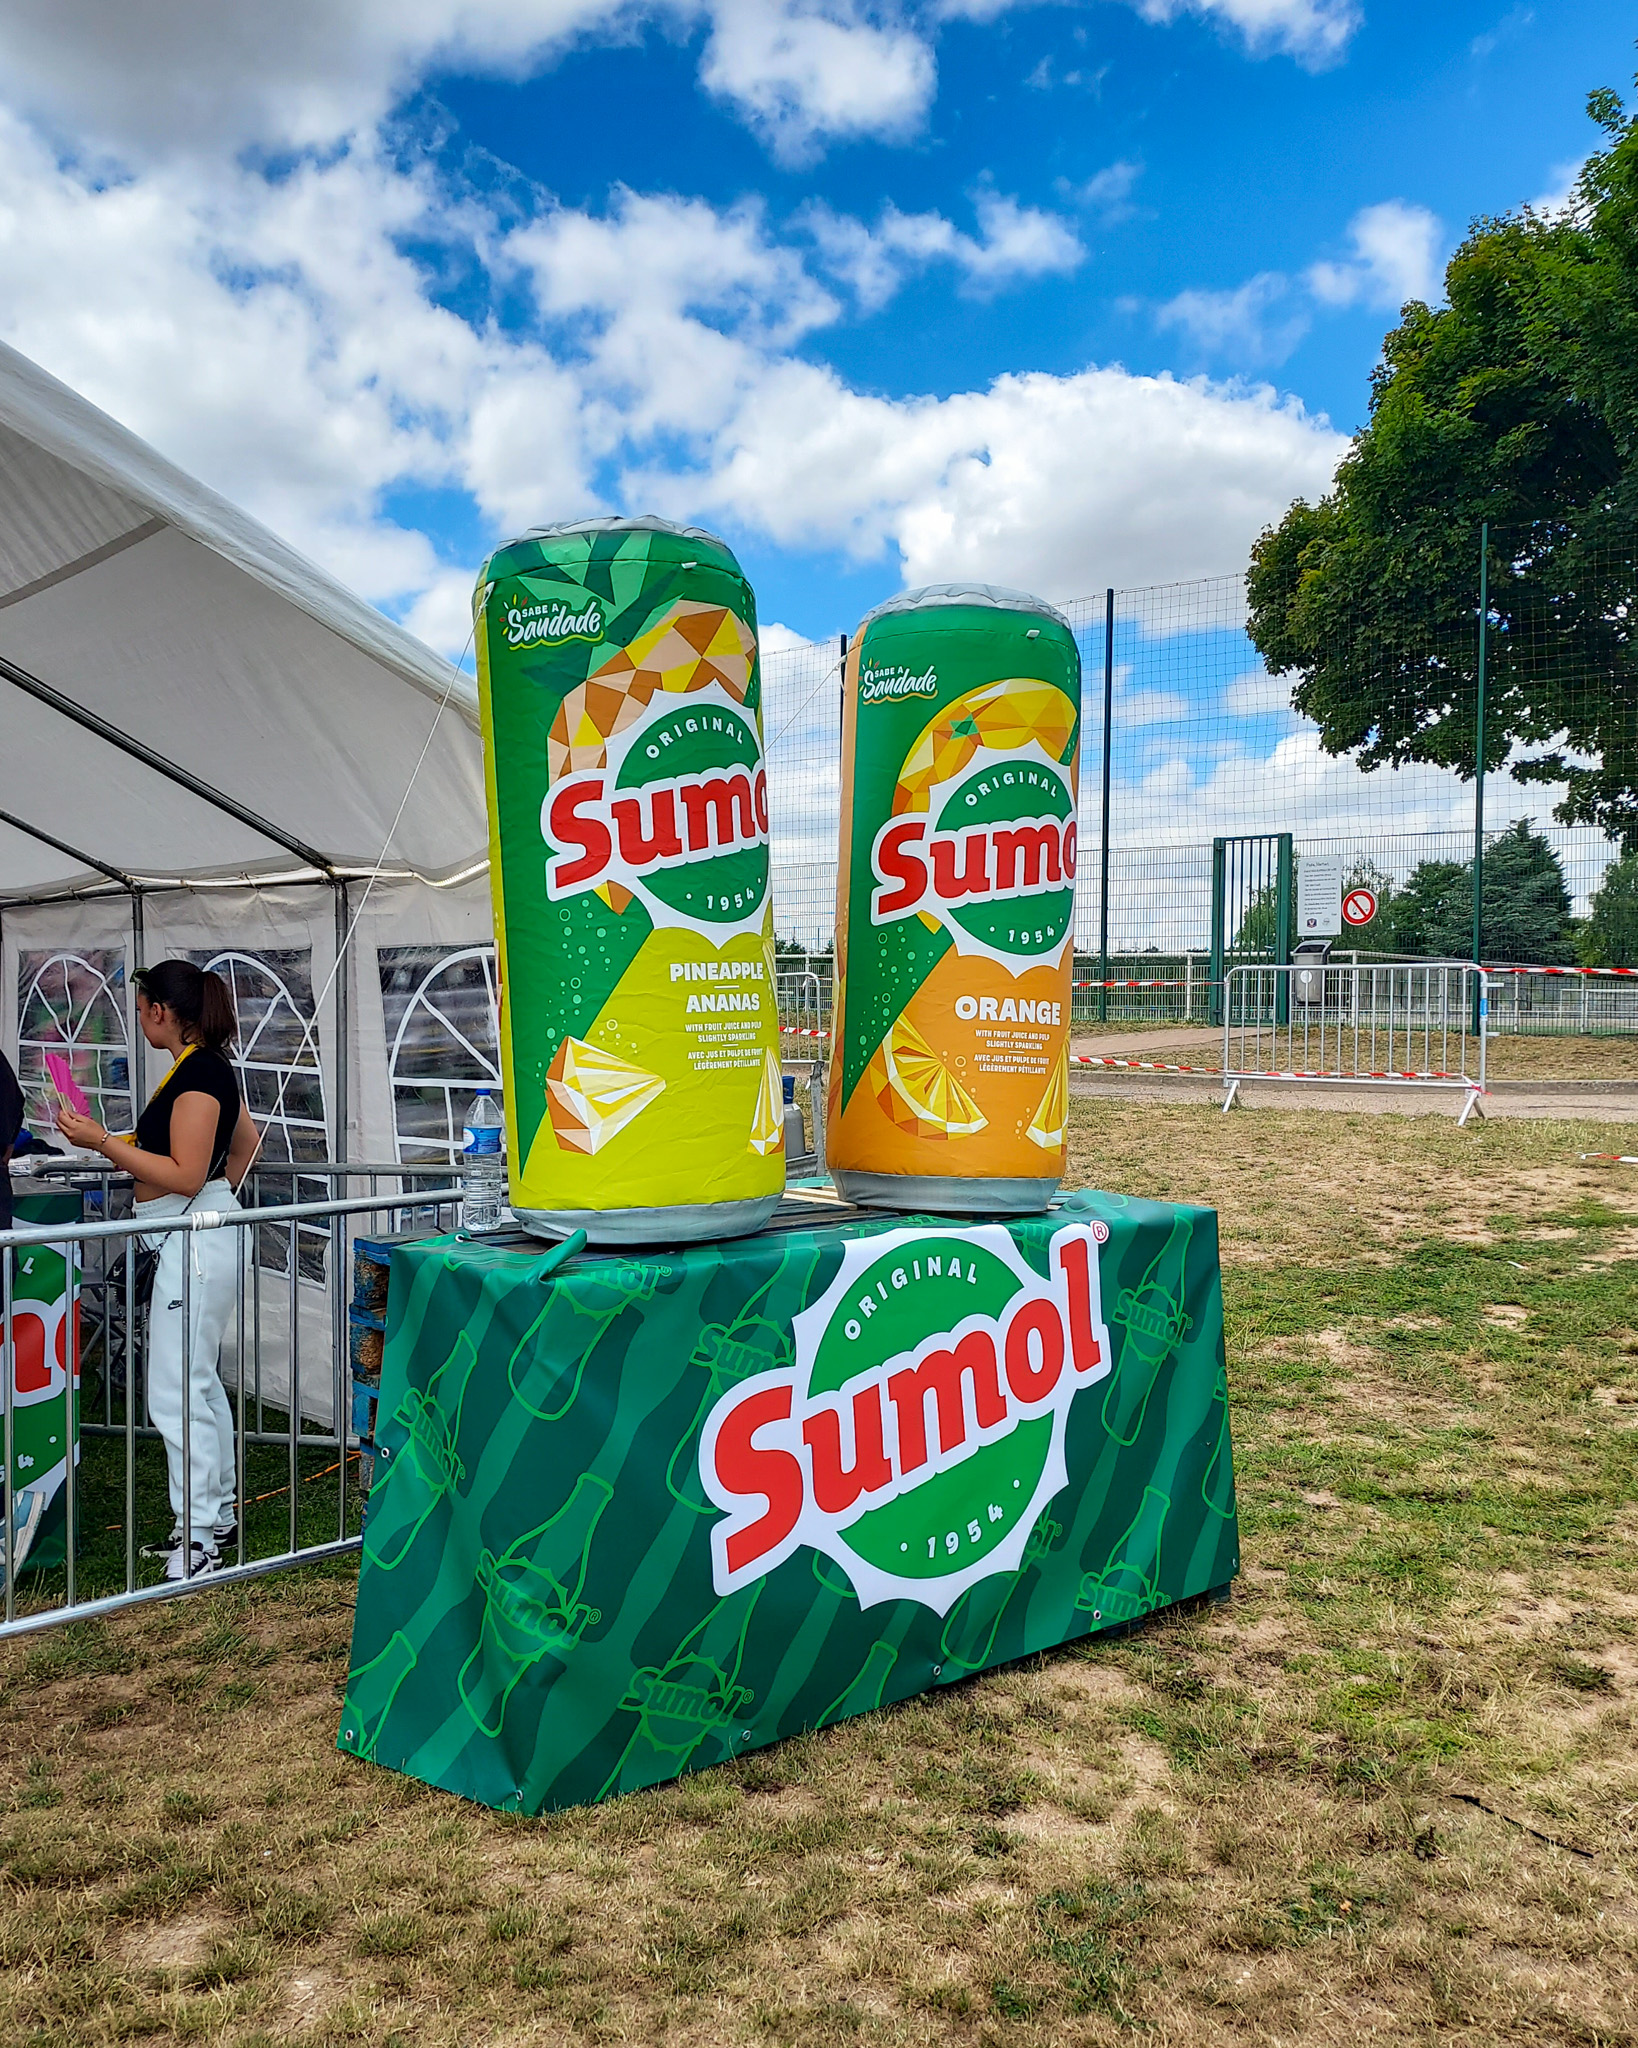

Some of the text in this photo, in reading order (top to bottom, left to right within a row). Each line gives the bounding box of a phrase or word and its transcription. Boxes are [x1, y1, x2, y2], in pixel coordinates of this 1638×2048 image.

[522, 603, 559, 618] SABE A
[897, 665, 904, 674] A
[646, 716, 743, 759] ORIGINAL
[965, 771, 1058, 807] ORIGINAL
[707, 887, 754, 911] 1954
[1009, 925, 1054, 945] 1954
[670, 962, 764, 982] PINEAPPLE
[686, 993, 760, 1013] ANANAS
[955, 995, 1061, 1026] ORANGE
[685, 1023, 704, 1032] WITH
[704, 1022, 723, 1031] FRUIT
[723, 1021, 740, 1031] JUICE
[740, 1021, 751, 1030] AND
[975, 1029, 992, 1038] WITH
[993, 1030, 1010, 1039] FRUIT
[1011, 1031, 1028, 1040] JUICE
[1028, 1032, 1038, 1040] AND
[697, 1032, 756, 1043] SLIGHTLY SPARKLING
[986, 1040, 1043, 1050] SLIGHTLY SPARKLING
[687, 1051, 705, 1060] AVEC
[706, 1050, 719, 1059] JUS
[719, 1050, 726, 1058] ET
[727, 1049, 744, 1057] PULPE
[744, 1048, 751, 1057] DE
[974, 1054, 990, 1062] AVEC
[991, 1054, 1004, 1062] JUS
[1005, 1055, 1012, 1063] ET
[1012, 1056, 1030, 1064] PULPE
[844, 1255, 979, 1341] ORIGINAL
[715, 1238, 1101, 1575] Sumol
[927, 1502, 1004, 1561] 1954
[617, 1666, 746, 1728] Sumol
